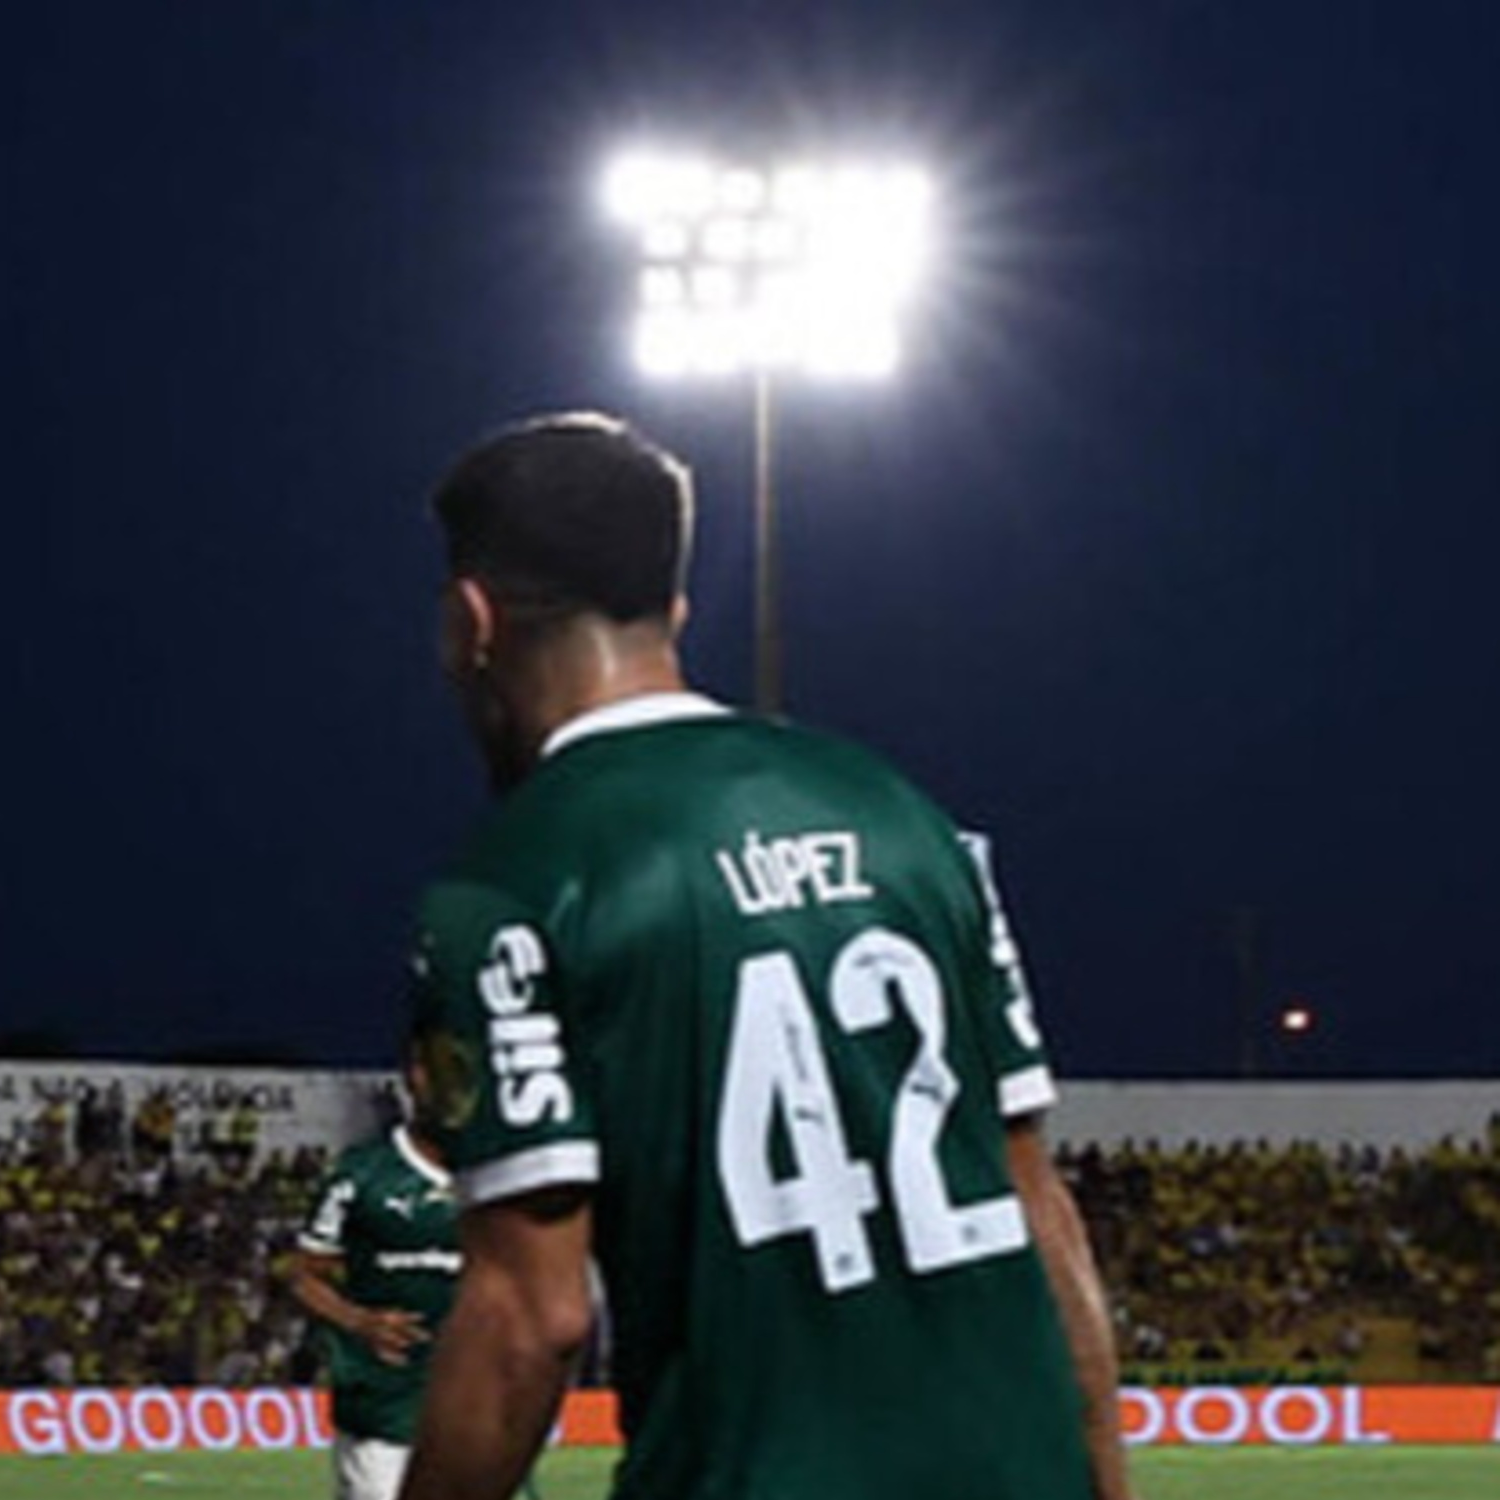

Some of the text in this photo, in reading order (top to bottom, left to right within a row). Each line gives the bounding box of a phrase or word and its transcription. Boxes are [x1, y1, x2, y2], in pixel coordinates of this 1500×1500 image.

[717, 831, 873, 914] LÓPEZ
[717, 926, 1029, 1292] 42
[8, 1387, 334, 1453] GOOOOL
